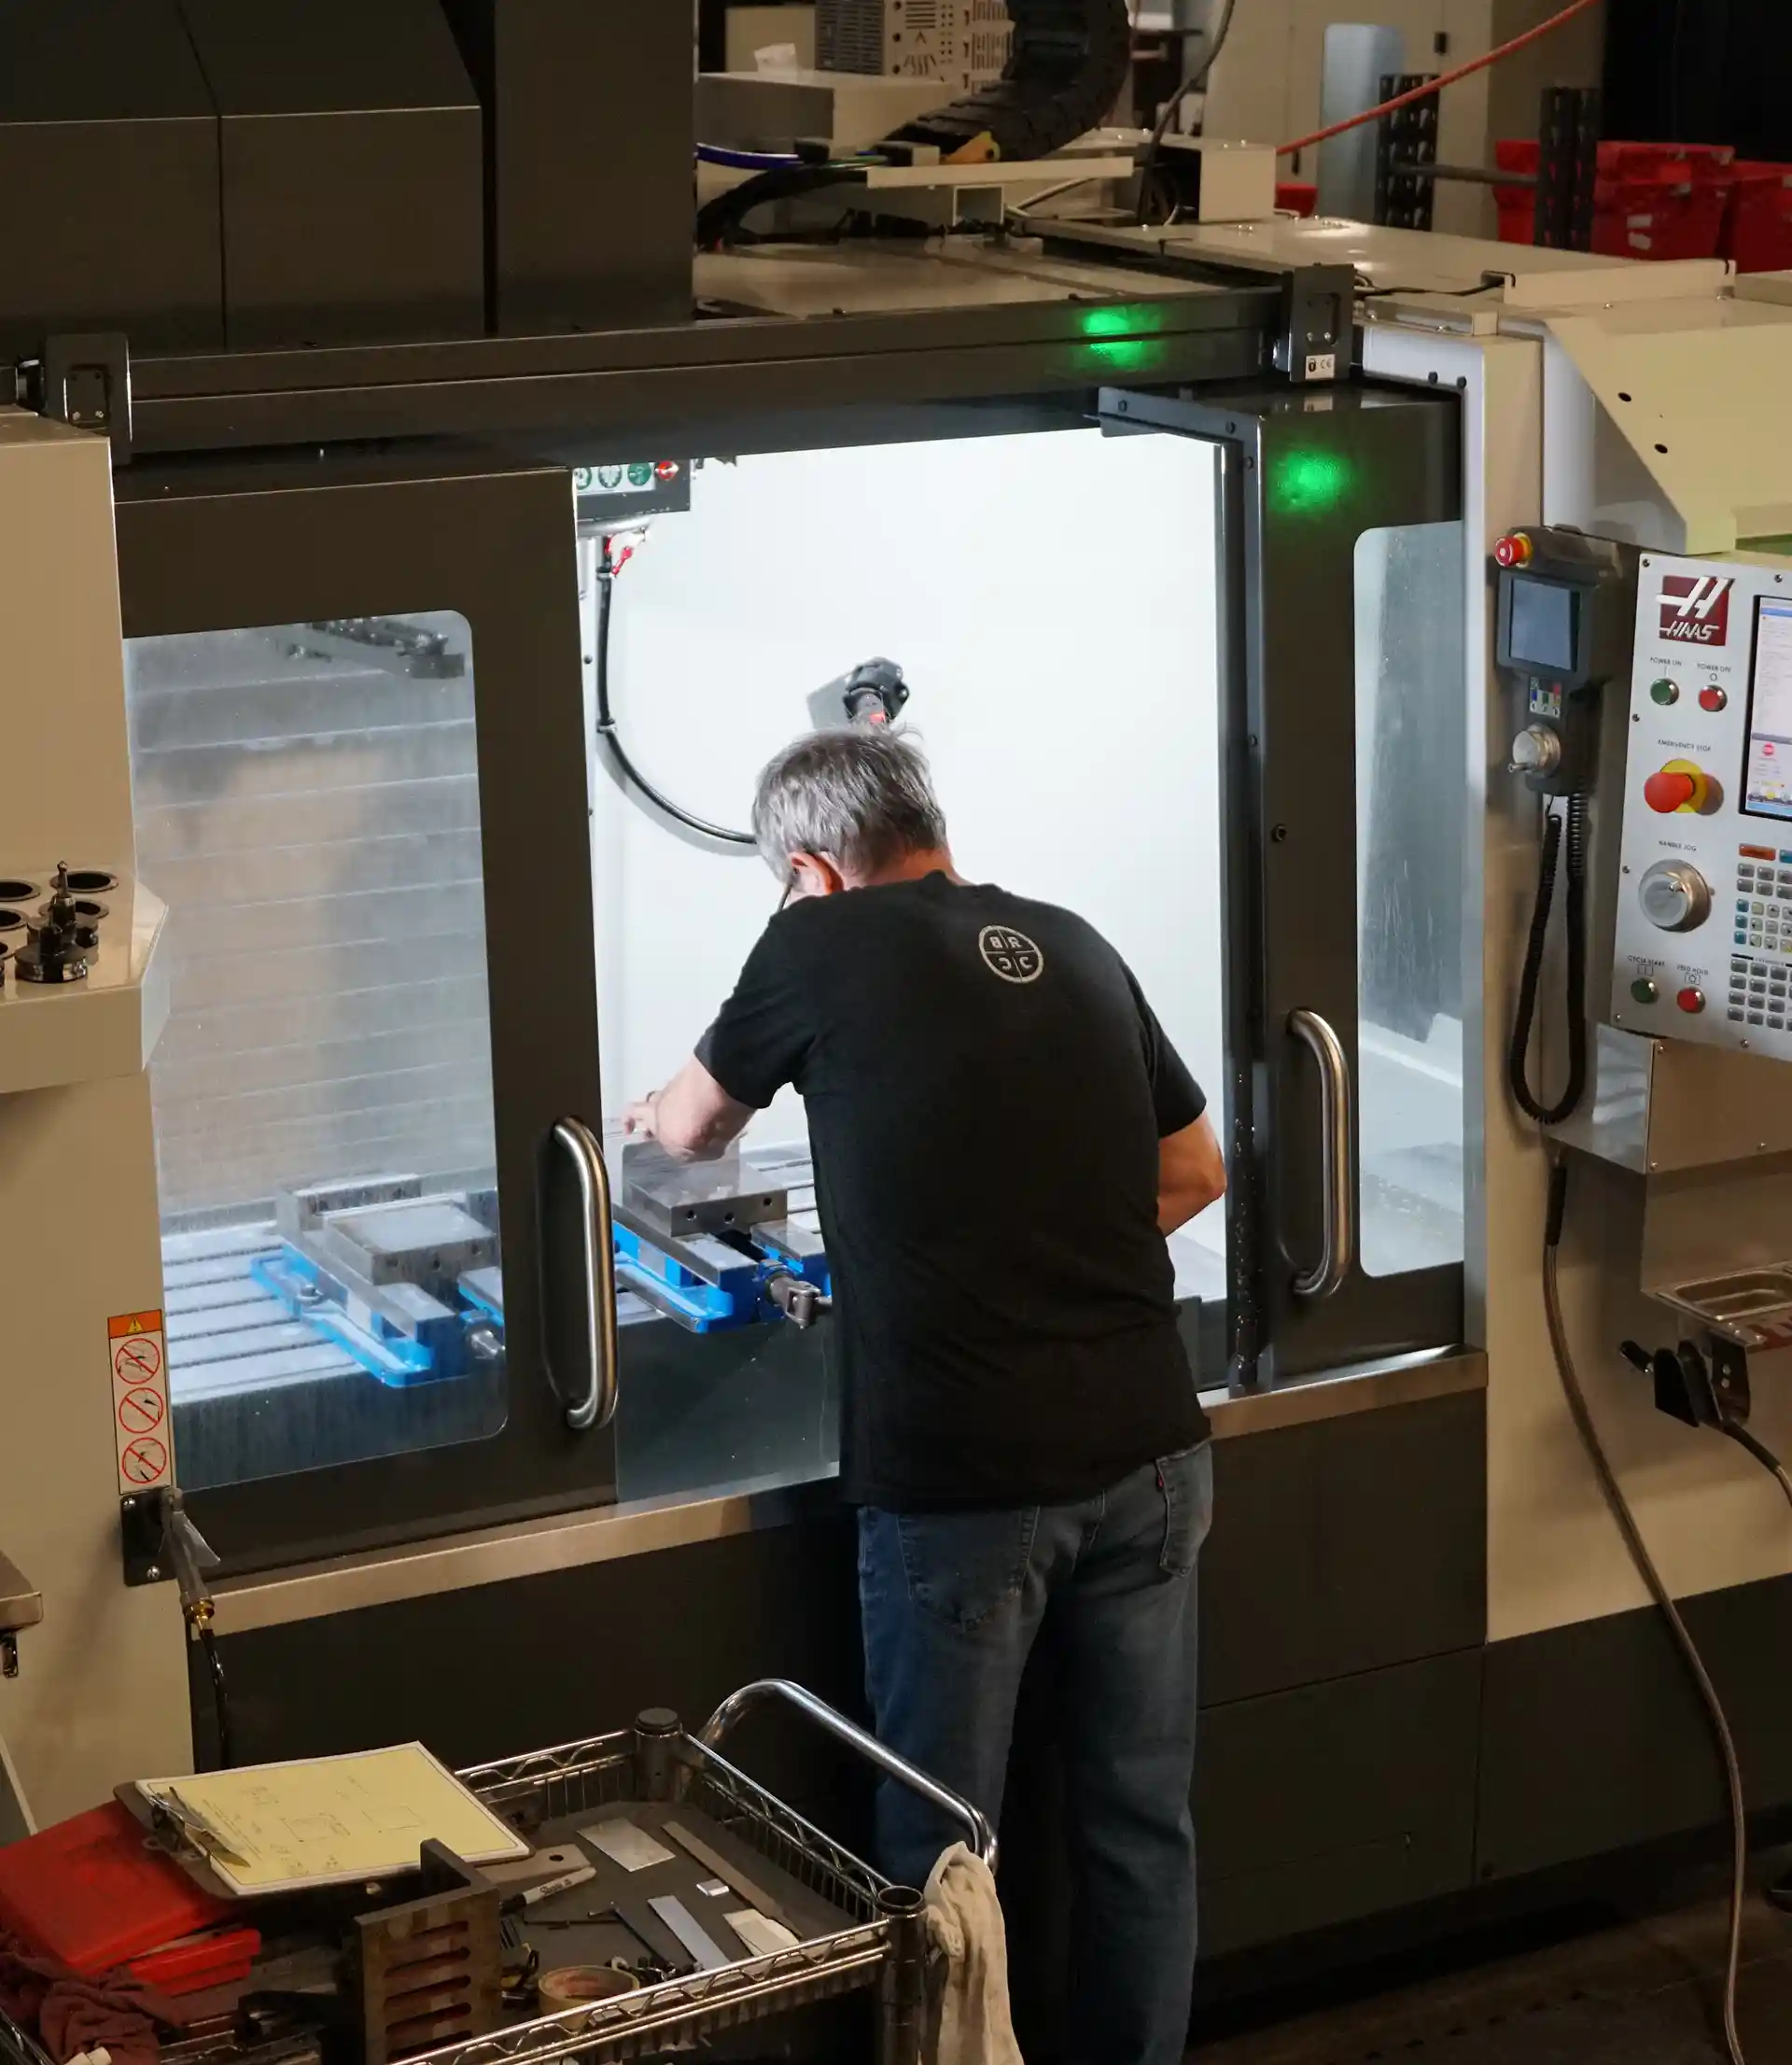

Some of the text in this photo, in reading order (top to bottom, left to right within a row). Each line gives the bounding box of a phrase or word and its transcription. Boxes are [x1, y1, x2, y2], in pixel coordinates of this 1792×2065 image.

[1660, 620, 1720, 640] HAAS
[1650, 656, 1671, 666] POWER
[1697, 662, 1718, 672] POWER
[1658, 738, 1695, 750] EMERGENCY
[1627, 954, 1646, 964] CYCLE
[1676, 963, 1709, 976] FEED HOLD
